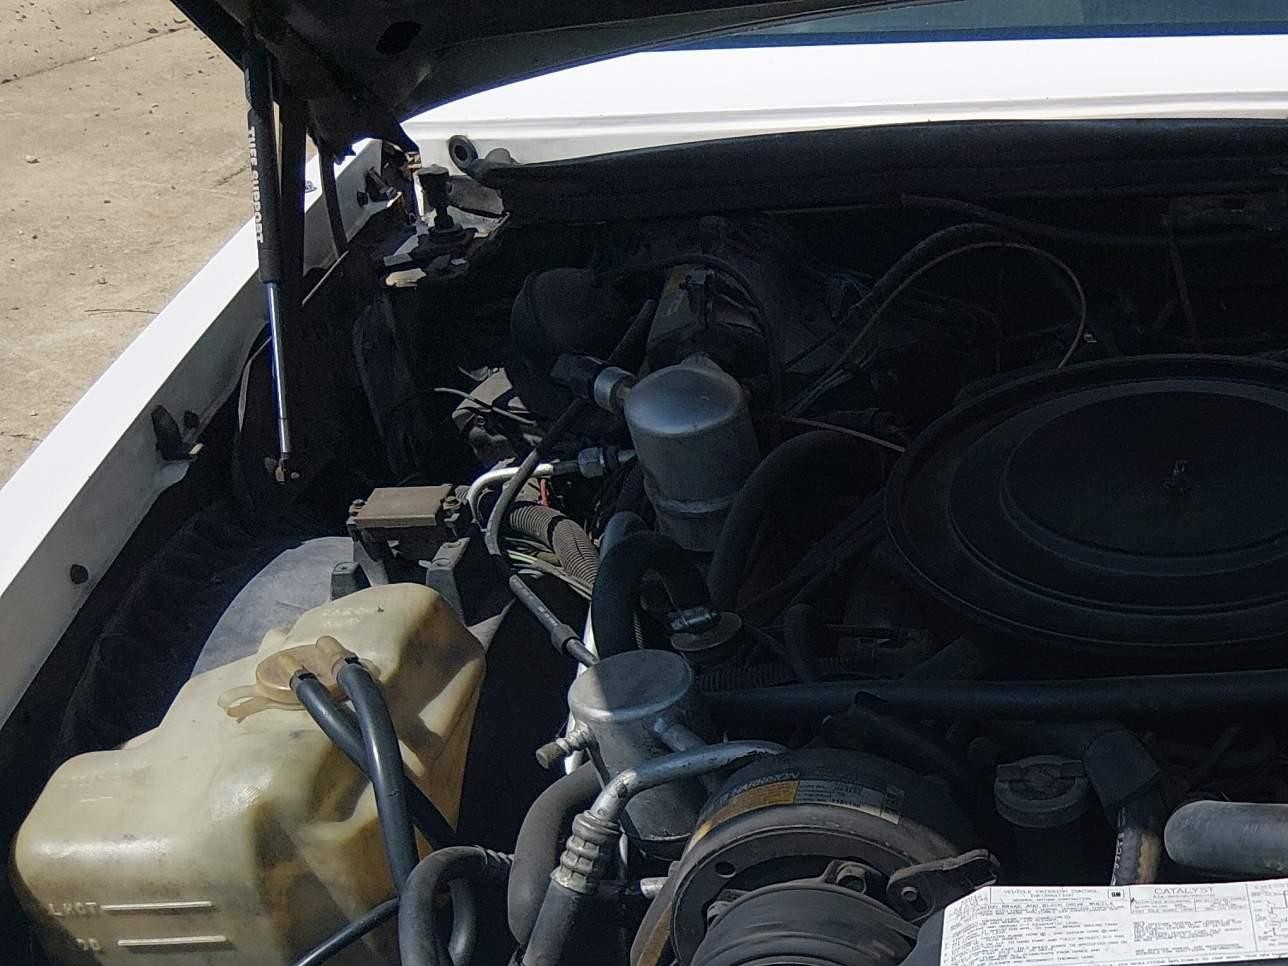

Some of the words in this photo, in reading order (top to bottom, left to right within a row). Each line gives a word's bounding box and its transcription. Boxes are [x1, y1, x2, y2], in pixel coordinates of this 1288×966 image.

[248, 126, 258, 166] TUFF
[250, 170, 264, 243] SUPPORT
[1154, 887, 1214, 895] CATALYST
